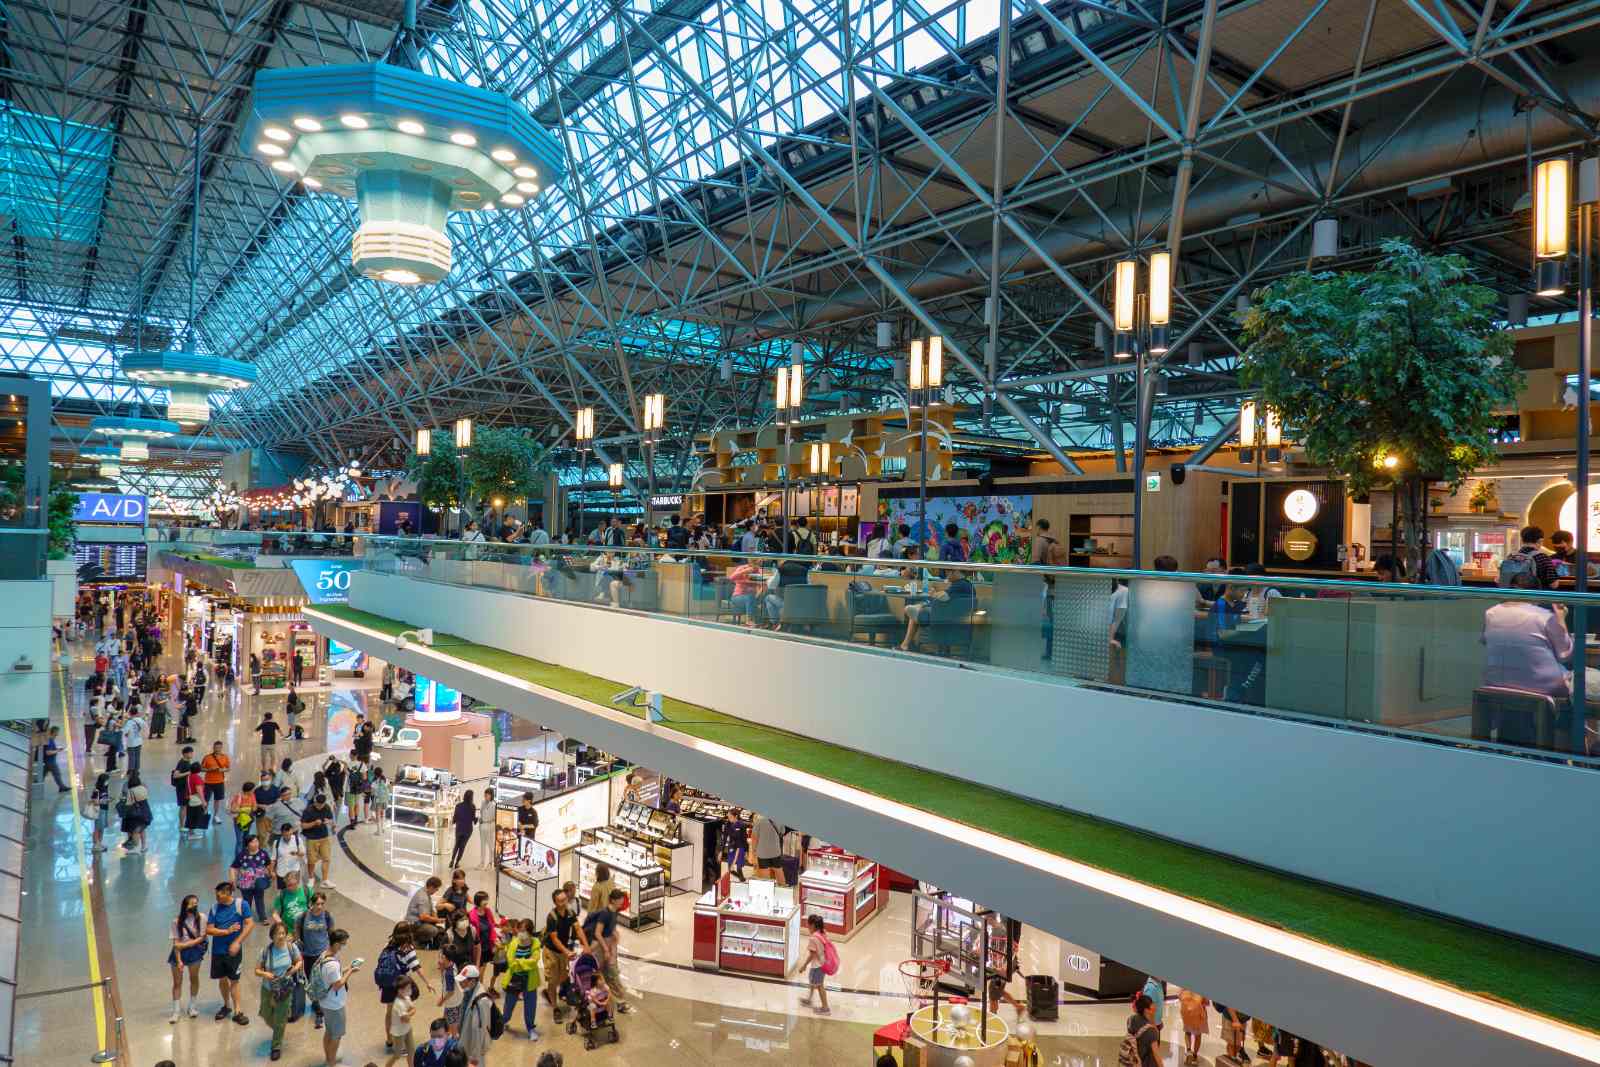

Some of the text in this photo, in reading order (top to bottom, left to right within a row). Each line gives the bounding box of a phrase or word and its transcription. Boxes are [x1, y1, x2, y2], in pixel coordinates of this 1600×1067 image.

[92, 498, 143, 518] A/D
[651, 496, 682, 505] TARBUCKS
[316, 571, 351, 590] 50
